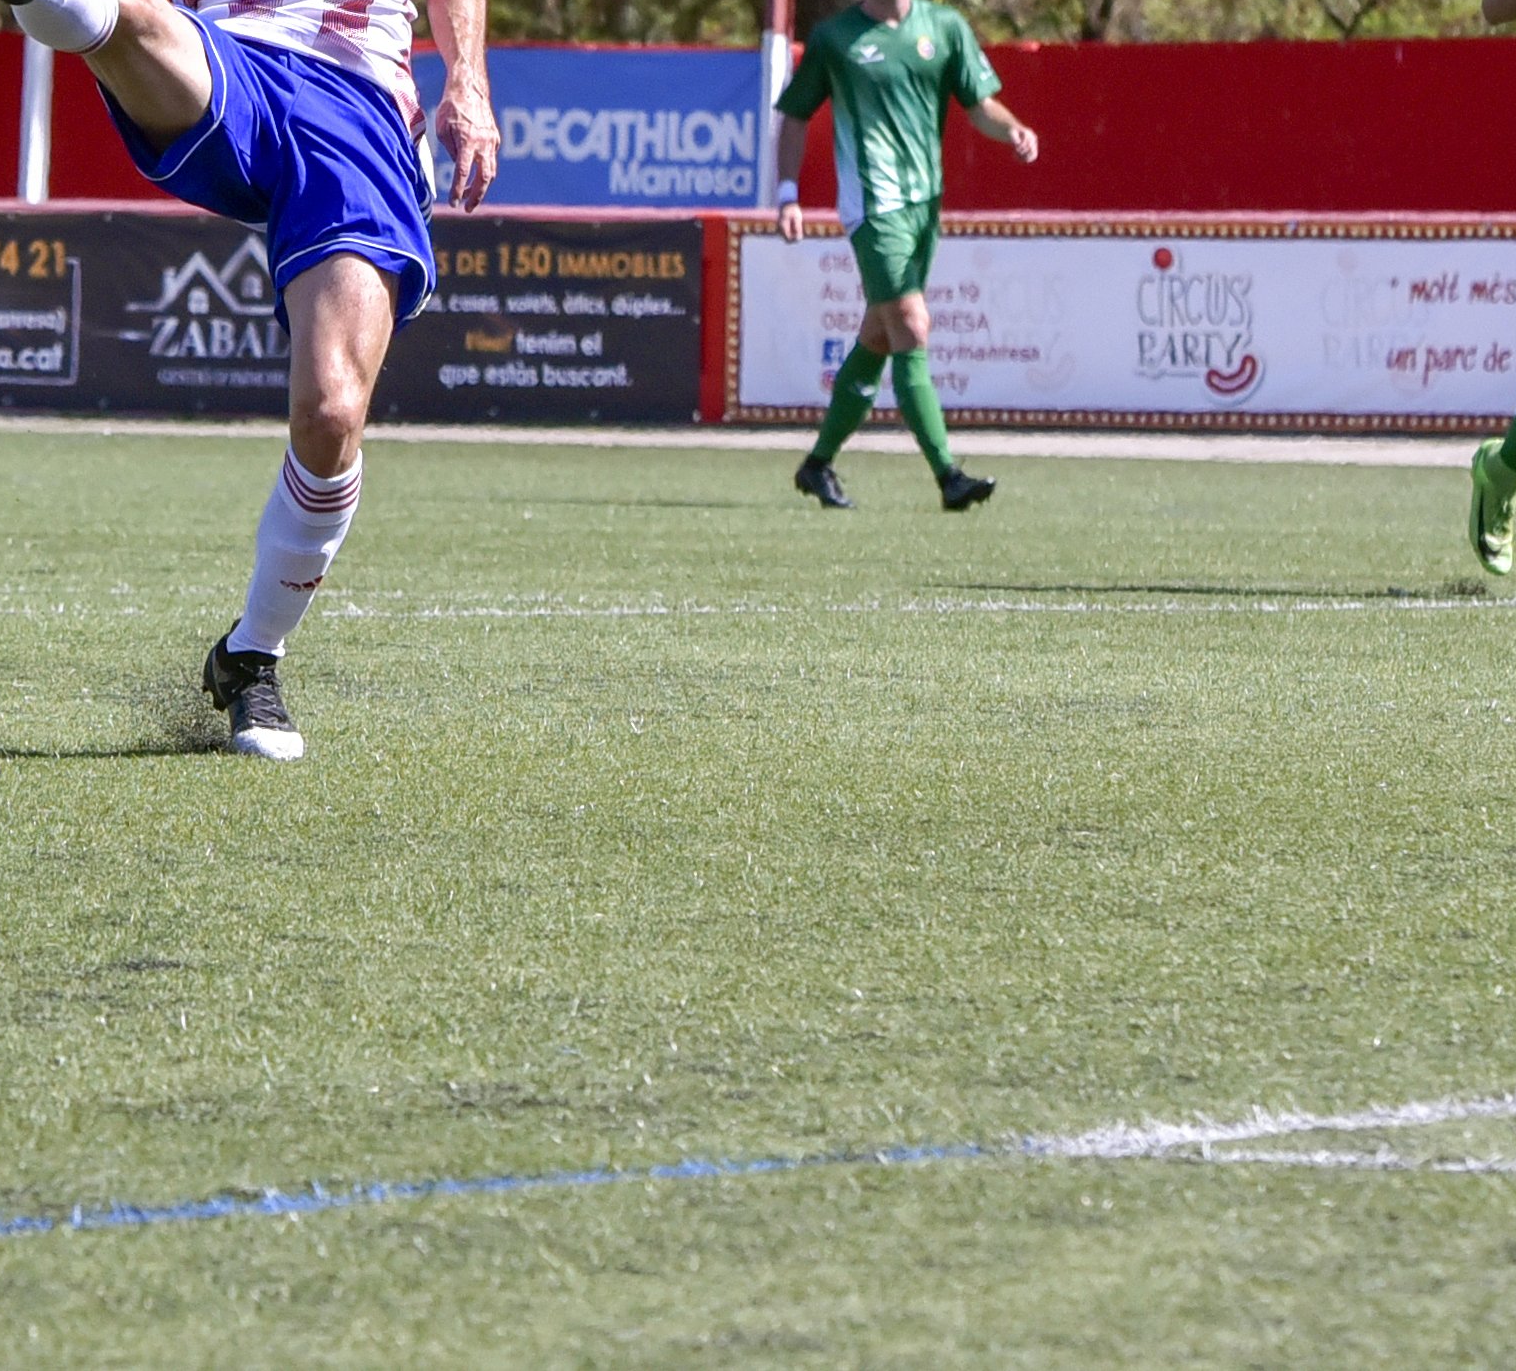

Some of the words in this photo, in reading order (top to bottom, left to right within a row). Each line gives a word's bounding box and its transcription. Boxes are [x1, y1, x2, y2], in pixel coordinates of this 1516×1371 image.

[500, 107, 755, 163] DECATHLON
[608, 161, 754, 197] Manresa
[28, 238, 67, 278] 21
[454, 249, 488, 277] DE
[499, 243, 553, 278] 150
[557, 250, 686, 278] IMMOBLES
[1137, 273, 1251, 328] CIRCUS
[1409, 272, 1459, 303] molt
[149, 315, 291, 359] ZABAL
[1138, 332, 1242, 368] PARTY
